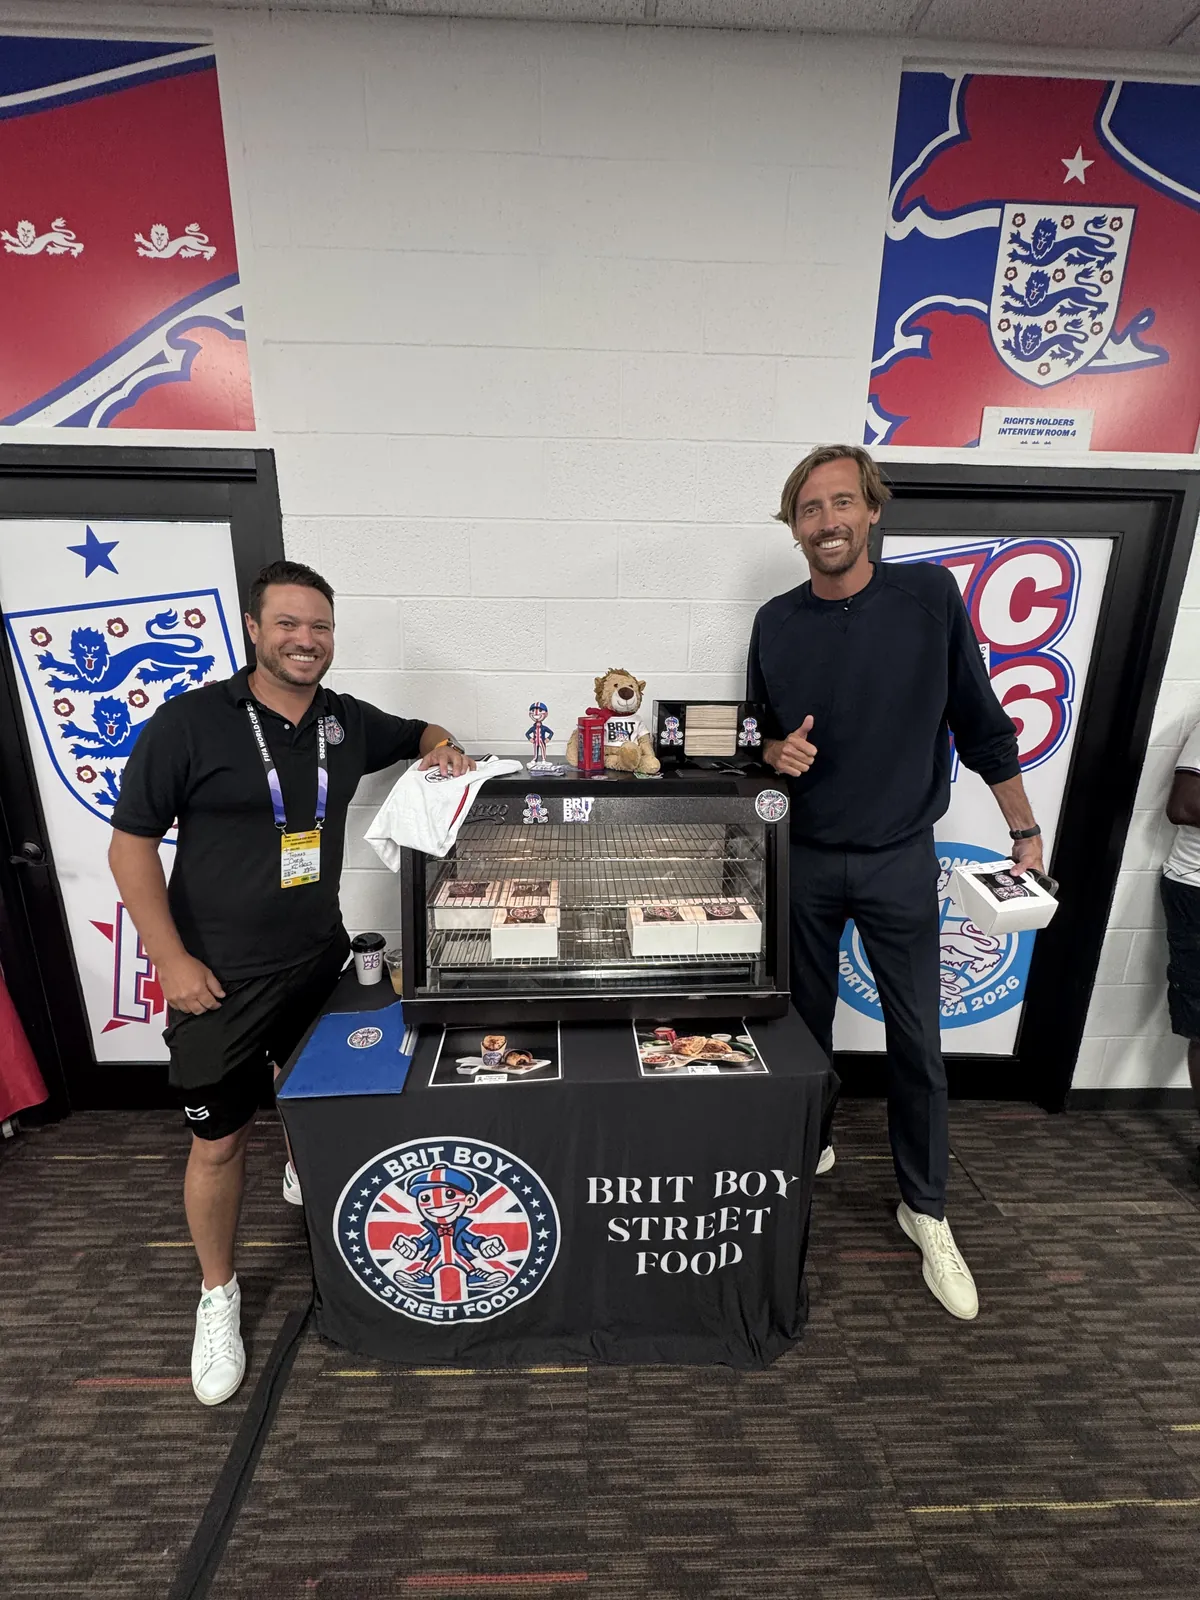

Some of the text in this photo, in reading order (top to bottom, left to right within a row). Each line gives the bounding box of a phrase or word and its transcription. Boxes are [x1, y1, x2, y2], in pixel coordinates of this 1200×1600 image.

[1003, 417, 1075, 426] RIGHTS HOLDERS
[998, 428, 1045, 436] INTERVIEW
[1045, 429, 1070, 437] ROOM
[249, 712, 258, 724] CUP
[607, 722, 636, 731] BRIT
[253, 724, 265, 748] WORLD
[608, 730, 634, 742] BY
[260, 747, 271, 762] FIFA
[563, 797, 595, 809] BRIT
[563, 808, 591, 822] BY
[363, 952, 380, 963] WC
[364, 960, 380, 970] 26
[971, 975, 1020, 1011] 2026
[383, 1146, 513, 1178] BRIT BOY
[586, 1169, 800, 1205] BRIT BOY
[607, 1206, 771, 1242] STREET
[635, 1241, 743, 1276] FOOD
[380, 1285, 520, 1319] STREET FOOD
